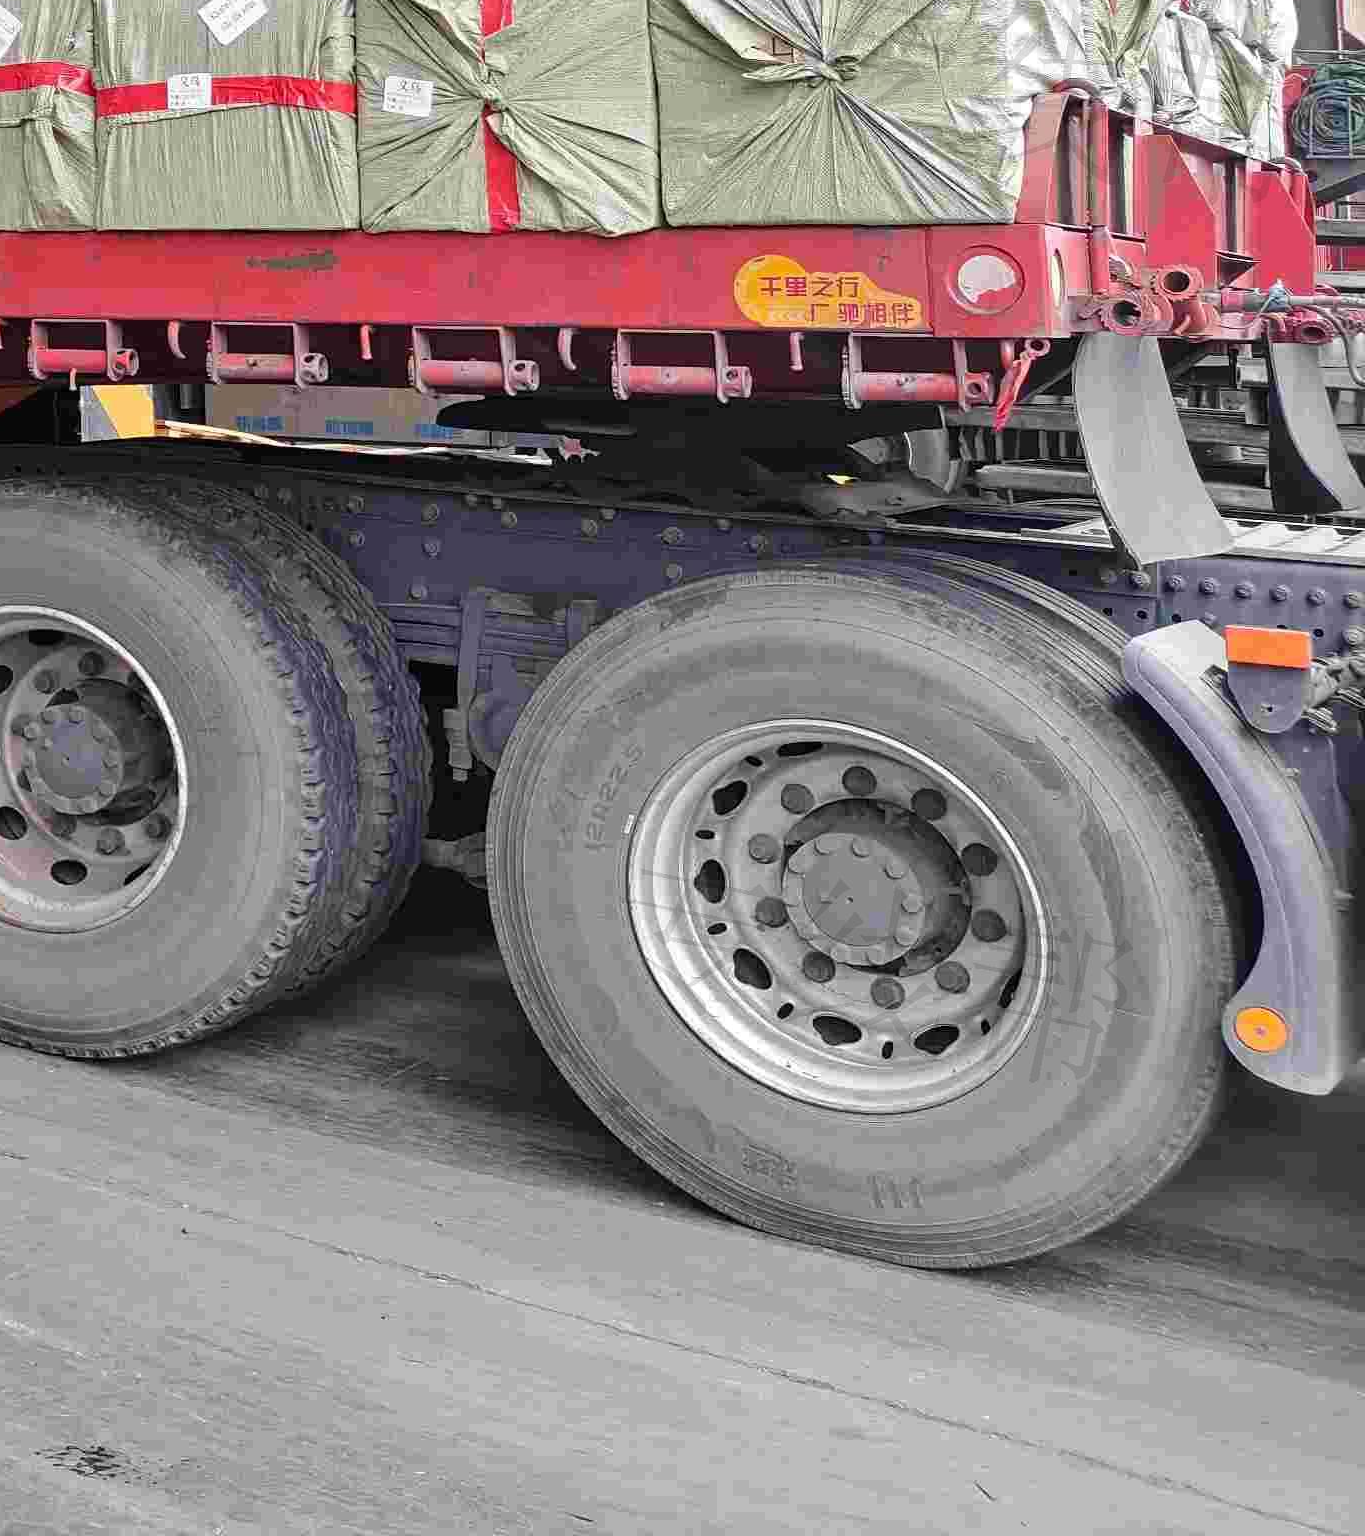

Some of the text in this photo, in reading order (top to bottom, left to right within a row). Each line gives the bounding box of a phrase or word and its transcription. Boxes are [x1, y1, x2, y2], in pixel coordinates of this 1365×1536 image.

[757, 275, 861, 298] 千里之行
[807, 301, 917, 328] 广驰相伴
